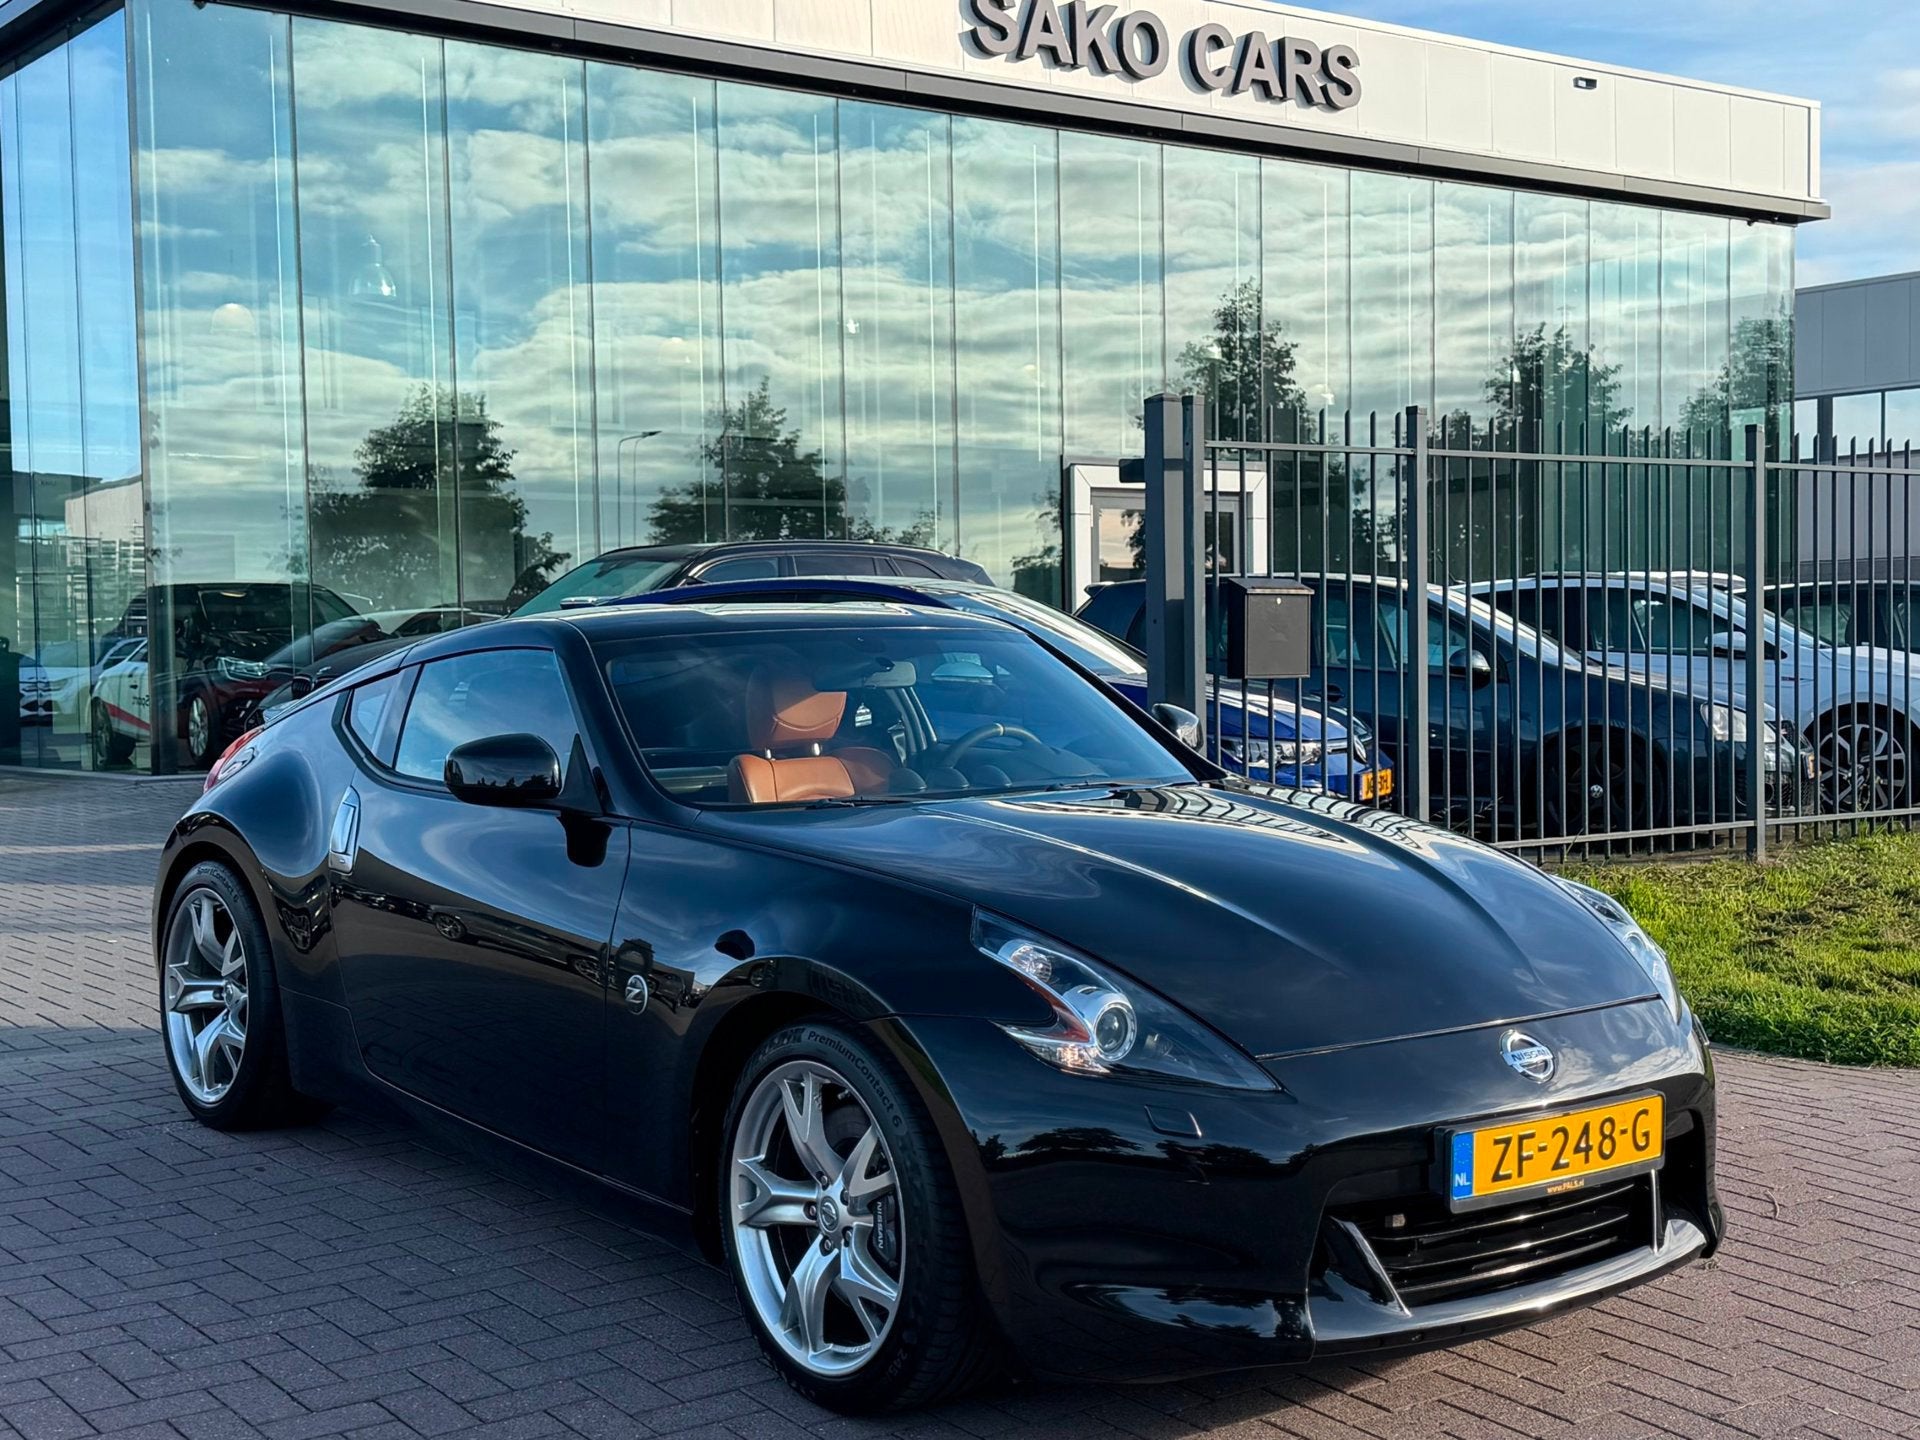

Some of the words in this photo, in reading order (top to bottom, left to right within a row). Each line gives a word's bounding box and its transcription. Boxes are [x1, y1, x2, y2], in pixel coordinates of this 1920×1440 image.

[965, 0, 1169, 80] SAKO
[1183, 23, 1362, 110] CARS
[807, 1030, 895, 1112] PremiumContact
[891, 1114, 903, 1128] 6
[1511, 1048, 1549, 1062] NISSAN
[1491, 1109, 1650, 1183] ZF-248-G
[1455, 1172, 1471, 1187] NL
[876, 1201, 885, 1249] NISSAN
